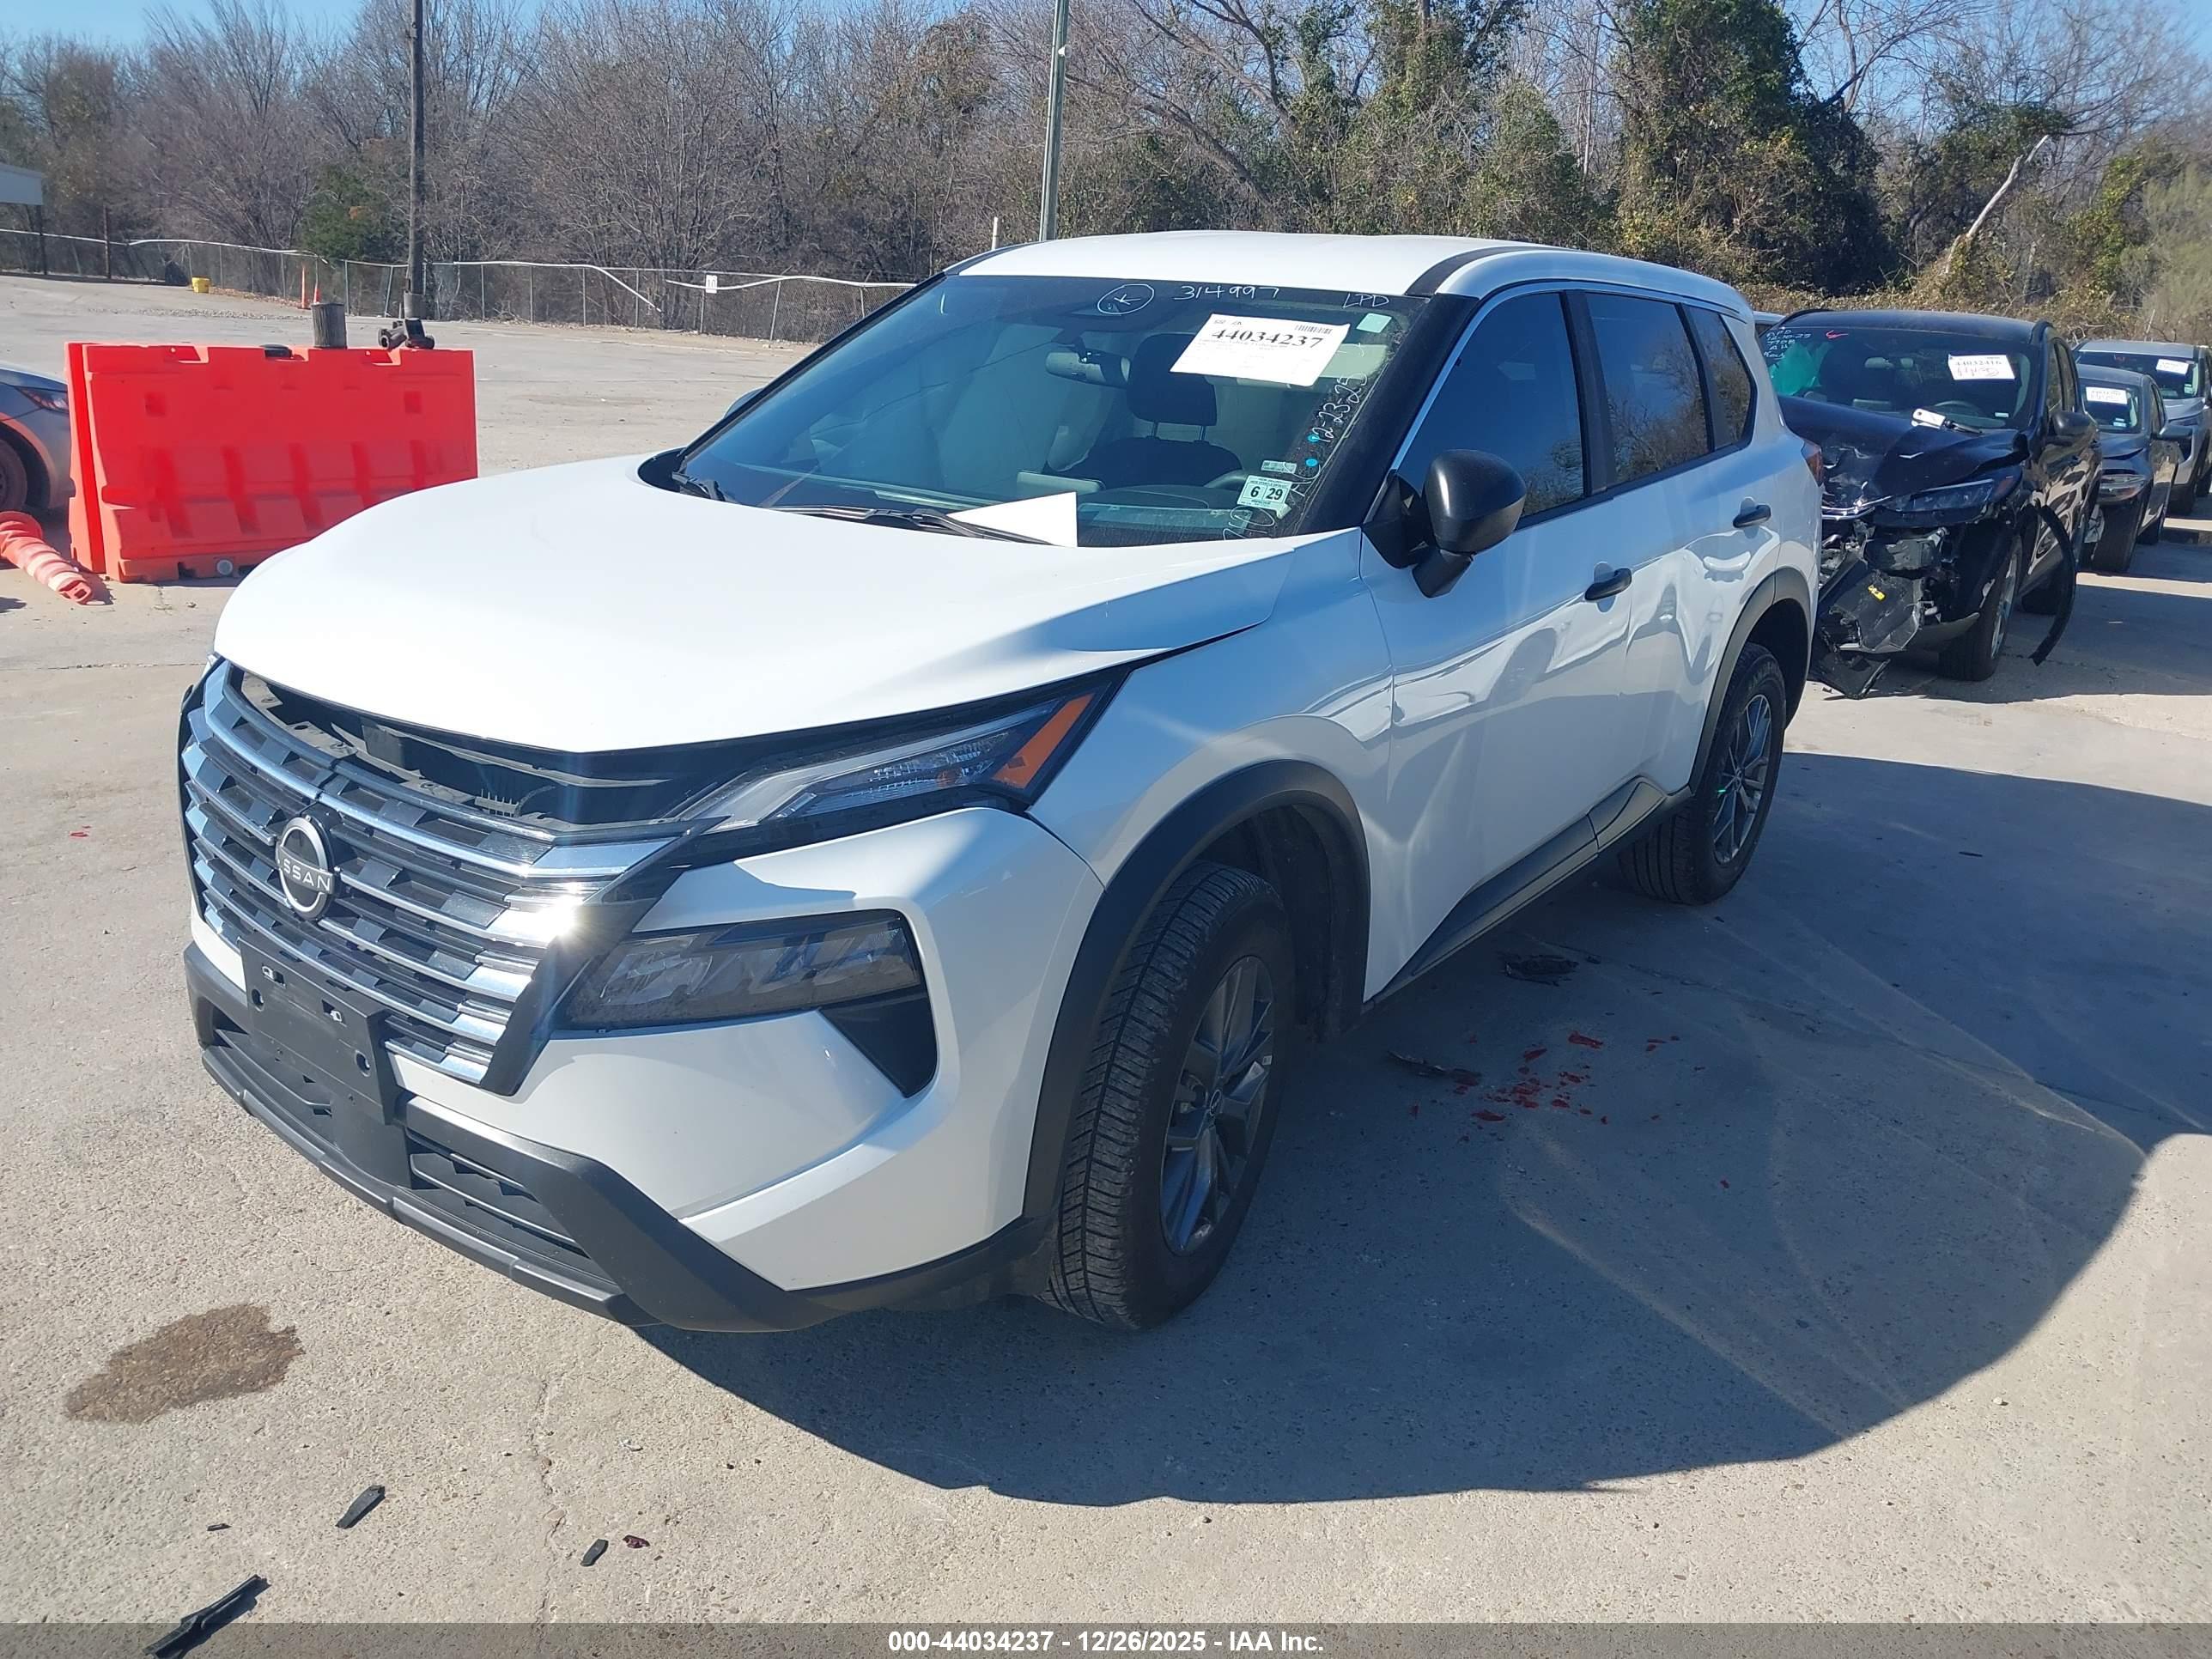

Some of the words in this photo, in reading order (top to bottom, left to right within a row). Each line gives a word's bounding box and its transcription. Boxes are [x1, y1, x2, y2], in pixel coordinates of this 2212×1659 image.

[1174, 285, 1279, 300] 314997
[1342, 293, 1389, 308] LPD
[1211, 329, 1324, 349] 44034237
[1311, 372, 1368, 443] 12-23-25
[1250, 486, 1261, 498] 6
[1265, 487, 1284, 501] 29
[282, 858, 331, 891] SSAN
